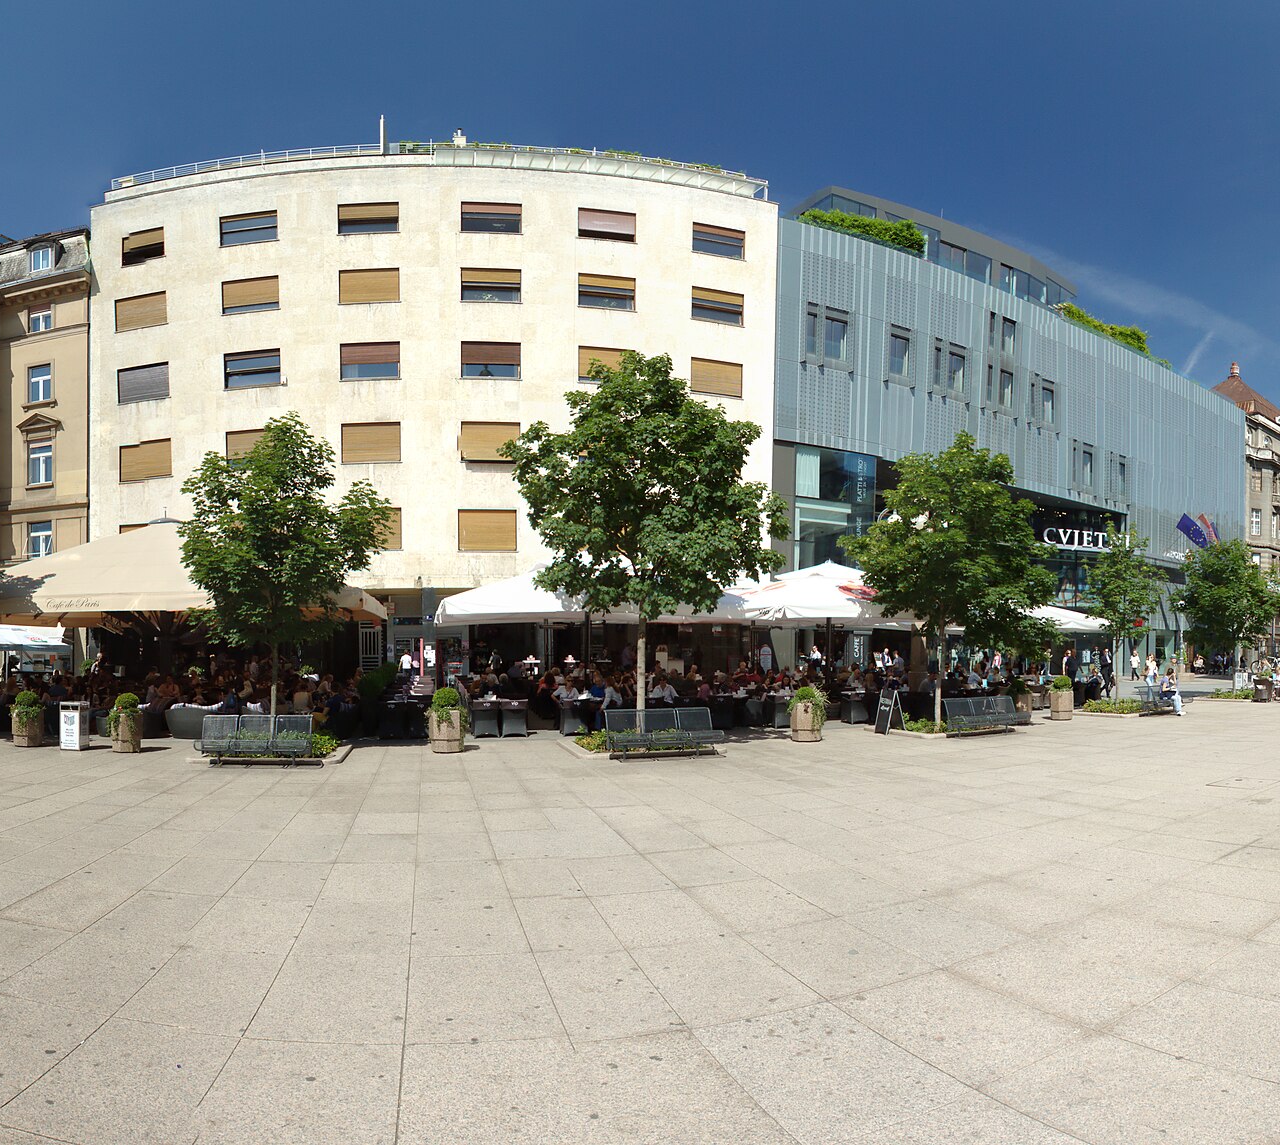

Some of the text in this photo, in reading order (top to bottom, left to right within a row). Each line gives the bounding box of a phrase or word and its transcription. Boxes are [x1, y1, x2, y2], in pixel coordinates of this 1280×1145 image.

[45, 597, 100, 610] Café de Paris
